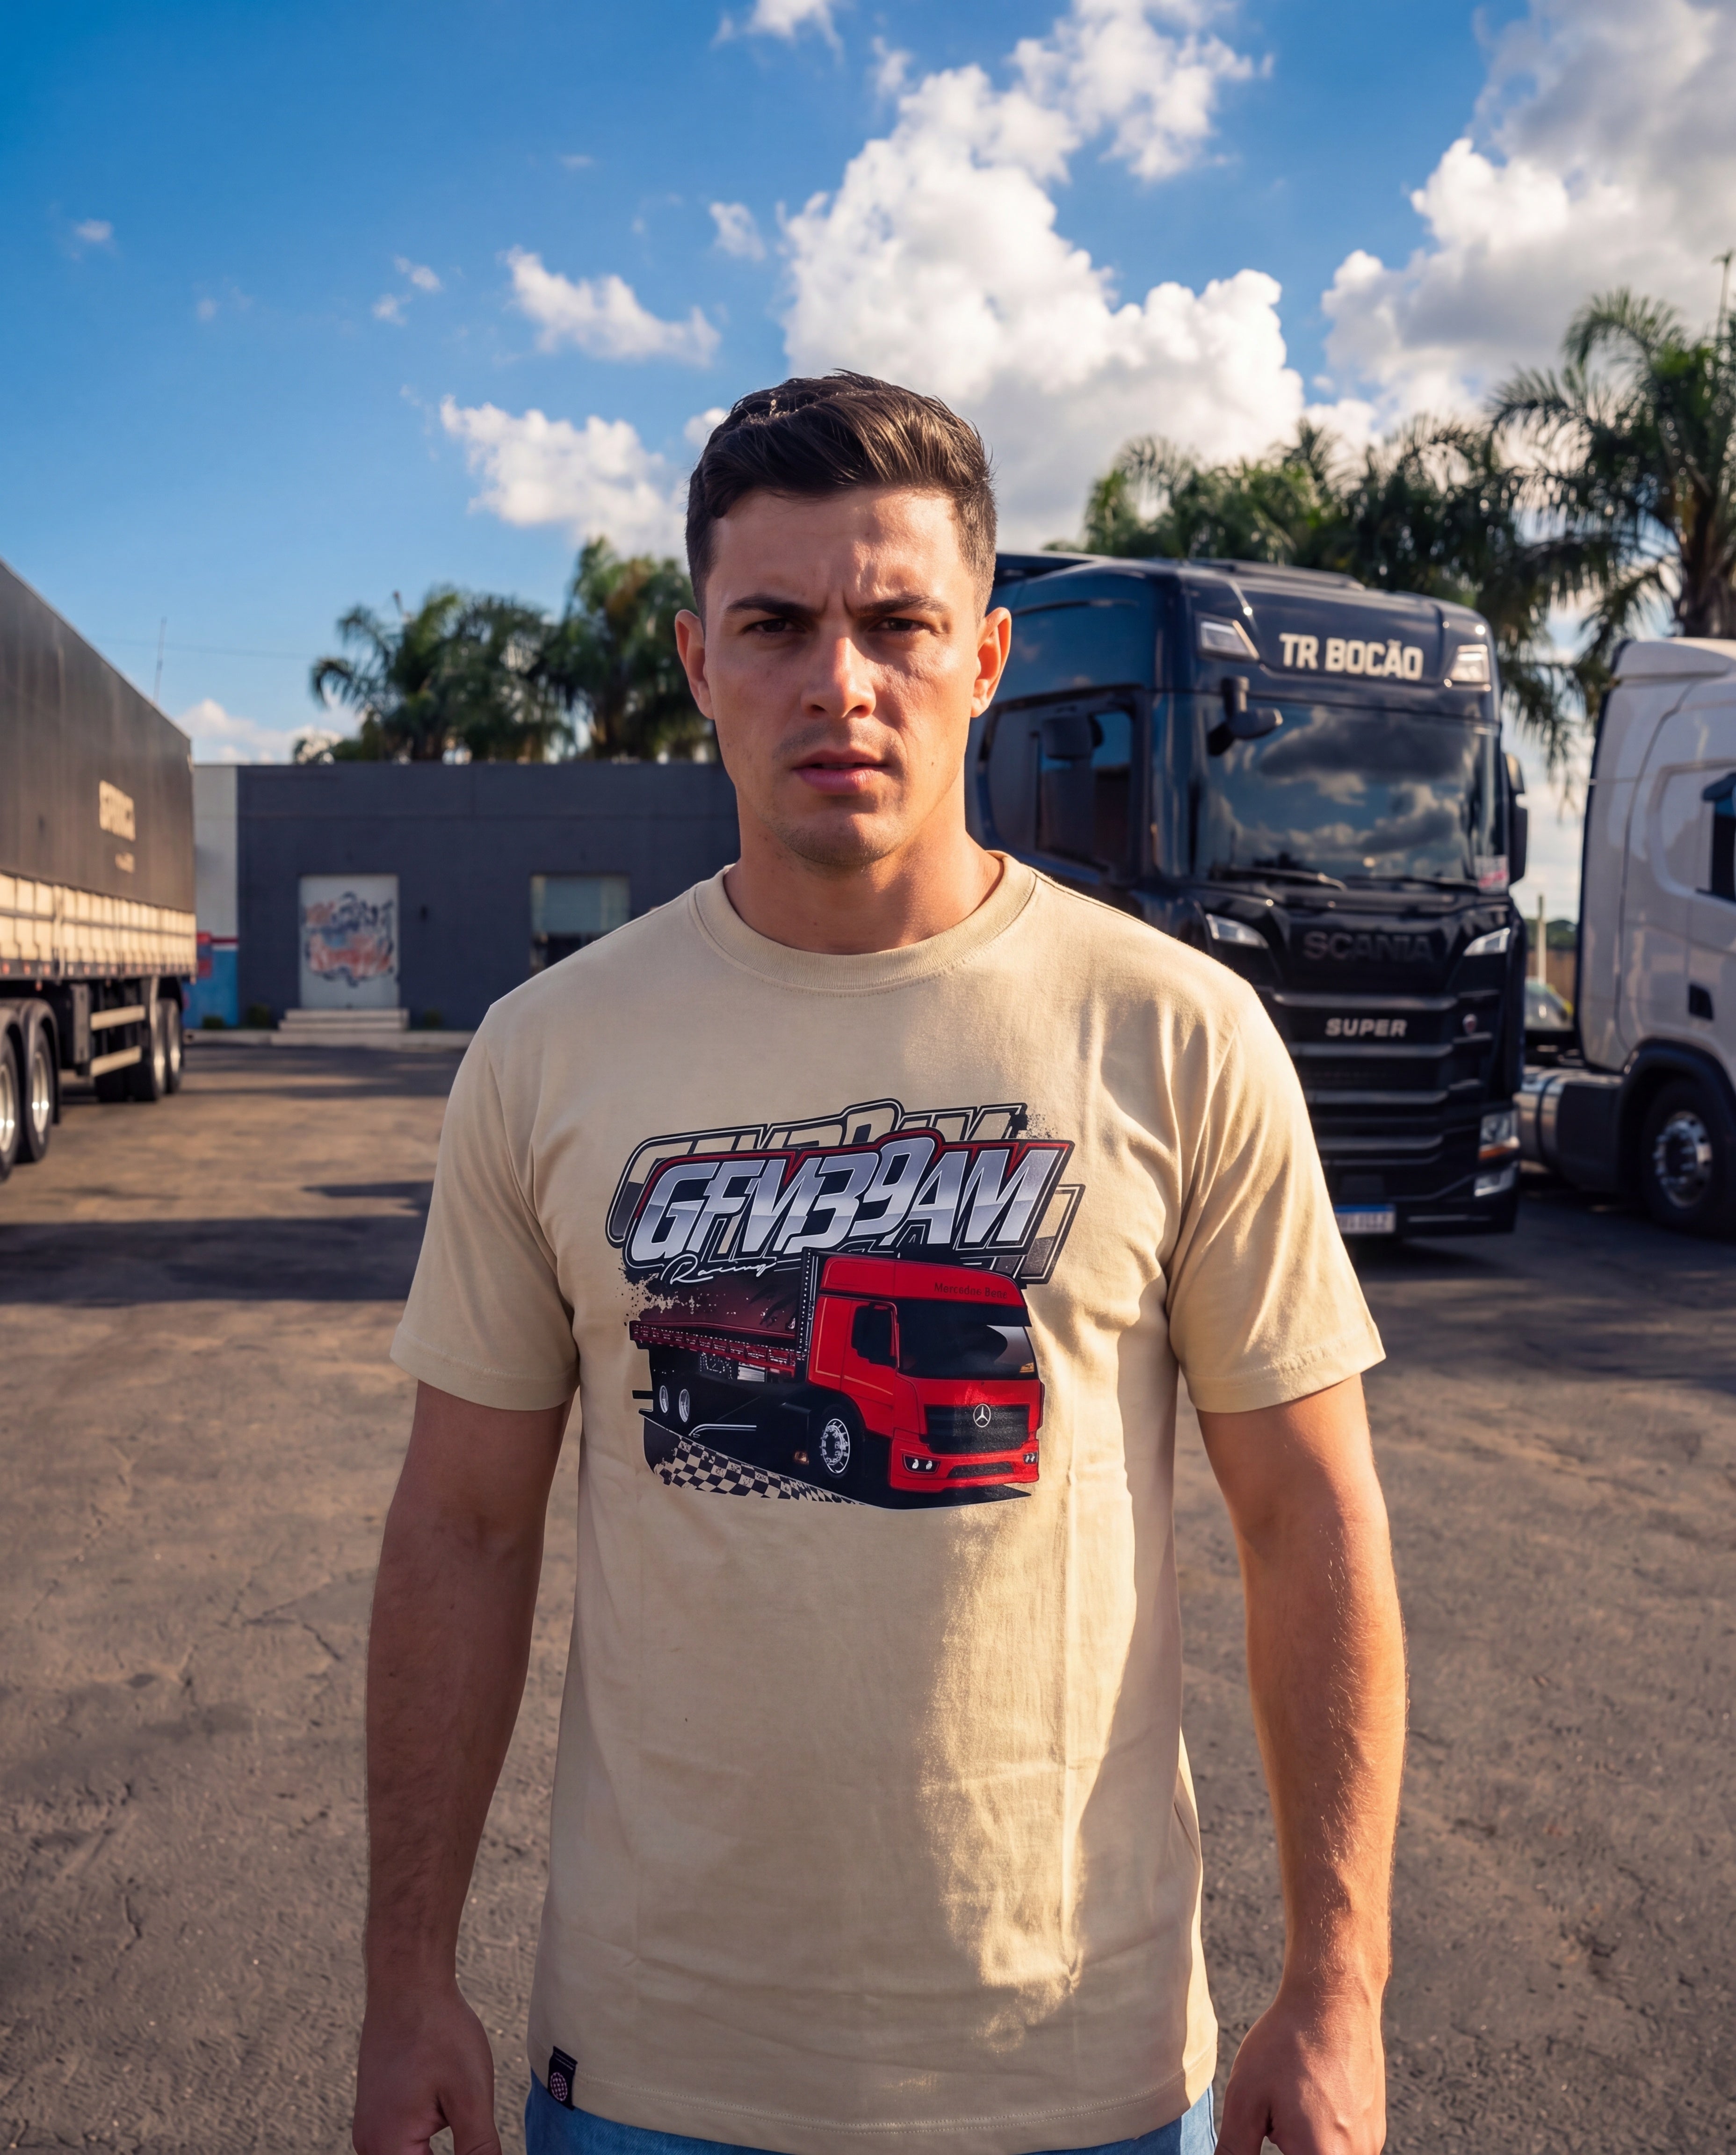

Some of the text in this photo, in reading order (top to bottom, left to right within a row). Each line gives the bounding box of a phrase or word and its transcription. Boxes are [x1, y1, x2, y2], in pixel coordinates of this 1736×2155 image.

[1279, 633, 1318, 670] TR
[1302, 930, 1435, 962] SCANIA
[1325, 1018, 1407, 1037] SUPER
[660, 1253, 777, 1285] Racing
